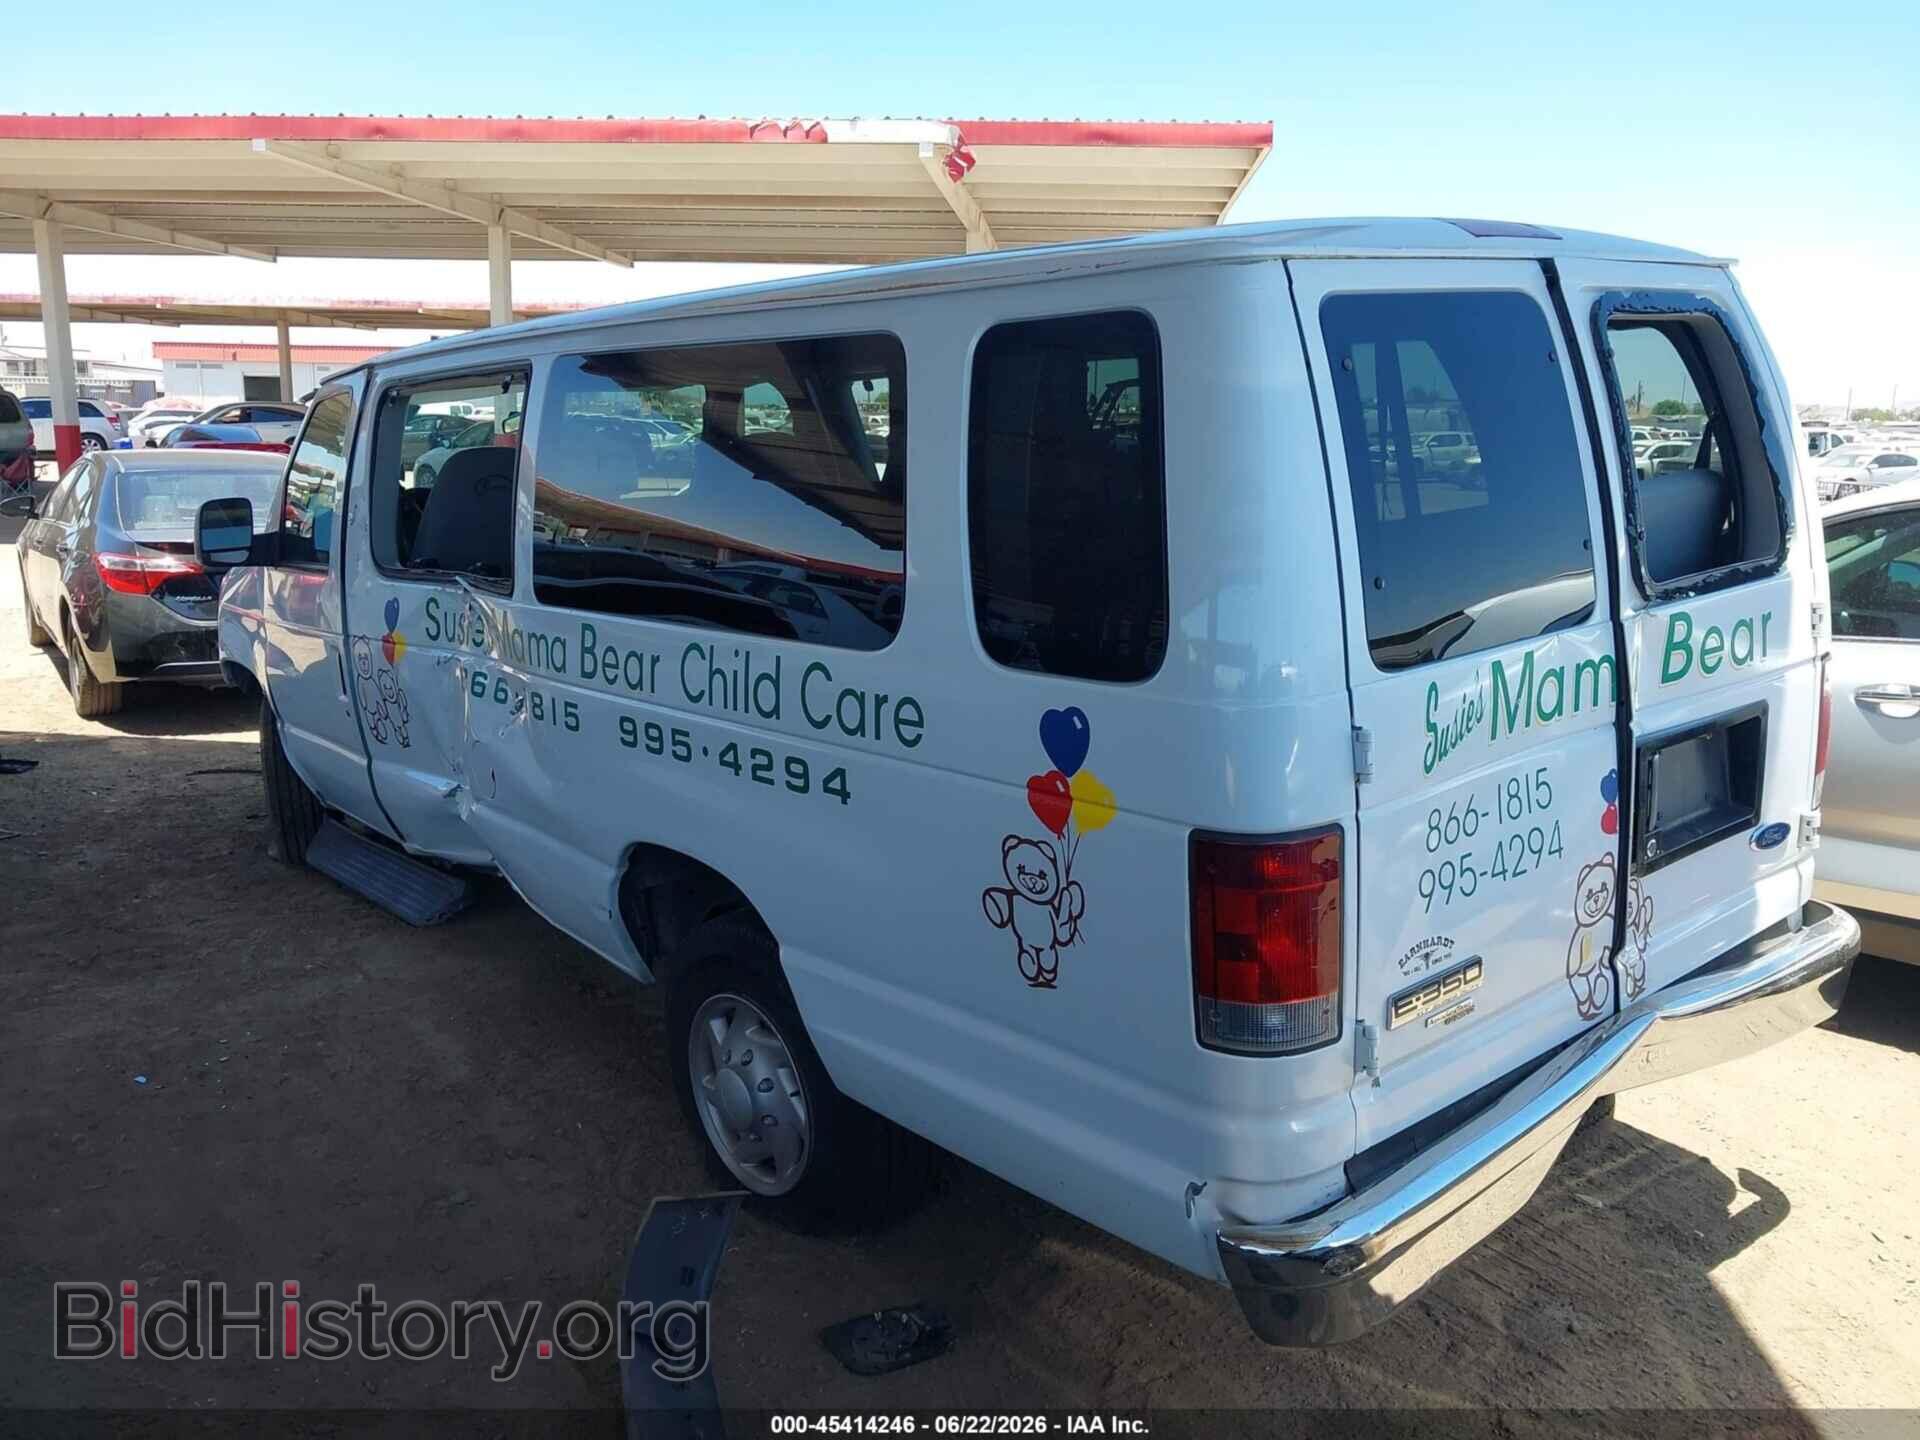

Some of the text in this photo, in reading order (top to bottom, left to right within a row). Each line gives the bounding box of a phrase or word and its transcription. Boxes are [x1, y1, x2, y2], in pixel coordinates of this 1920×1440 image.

[580, 622, 661, 694] Bear
[680, 642, 781, 720] Child
[800, 661, 924, 748] Care
[1661, 611, 1772, 684] Bear
[1426, 767, 1552, 853] 866-1815
[1419, 819, 1564, 914] 995-4294
